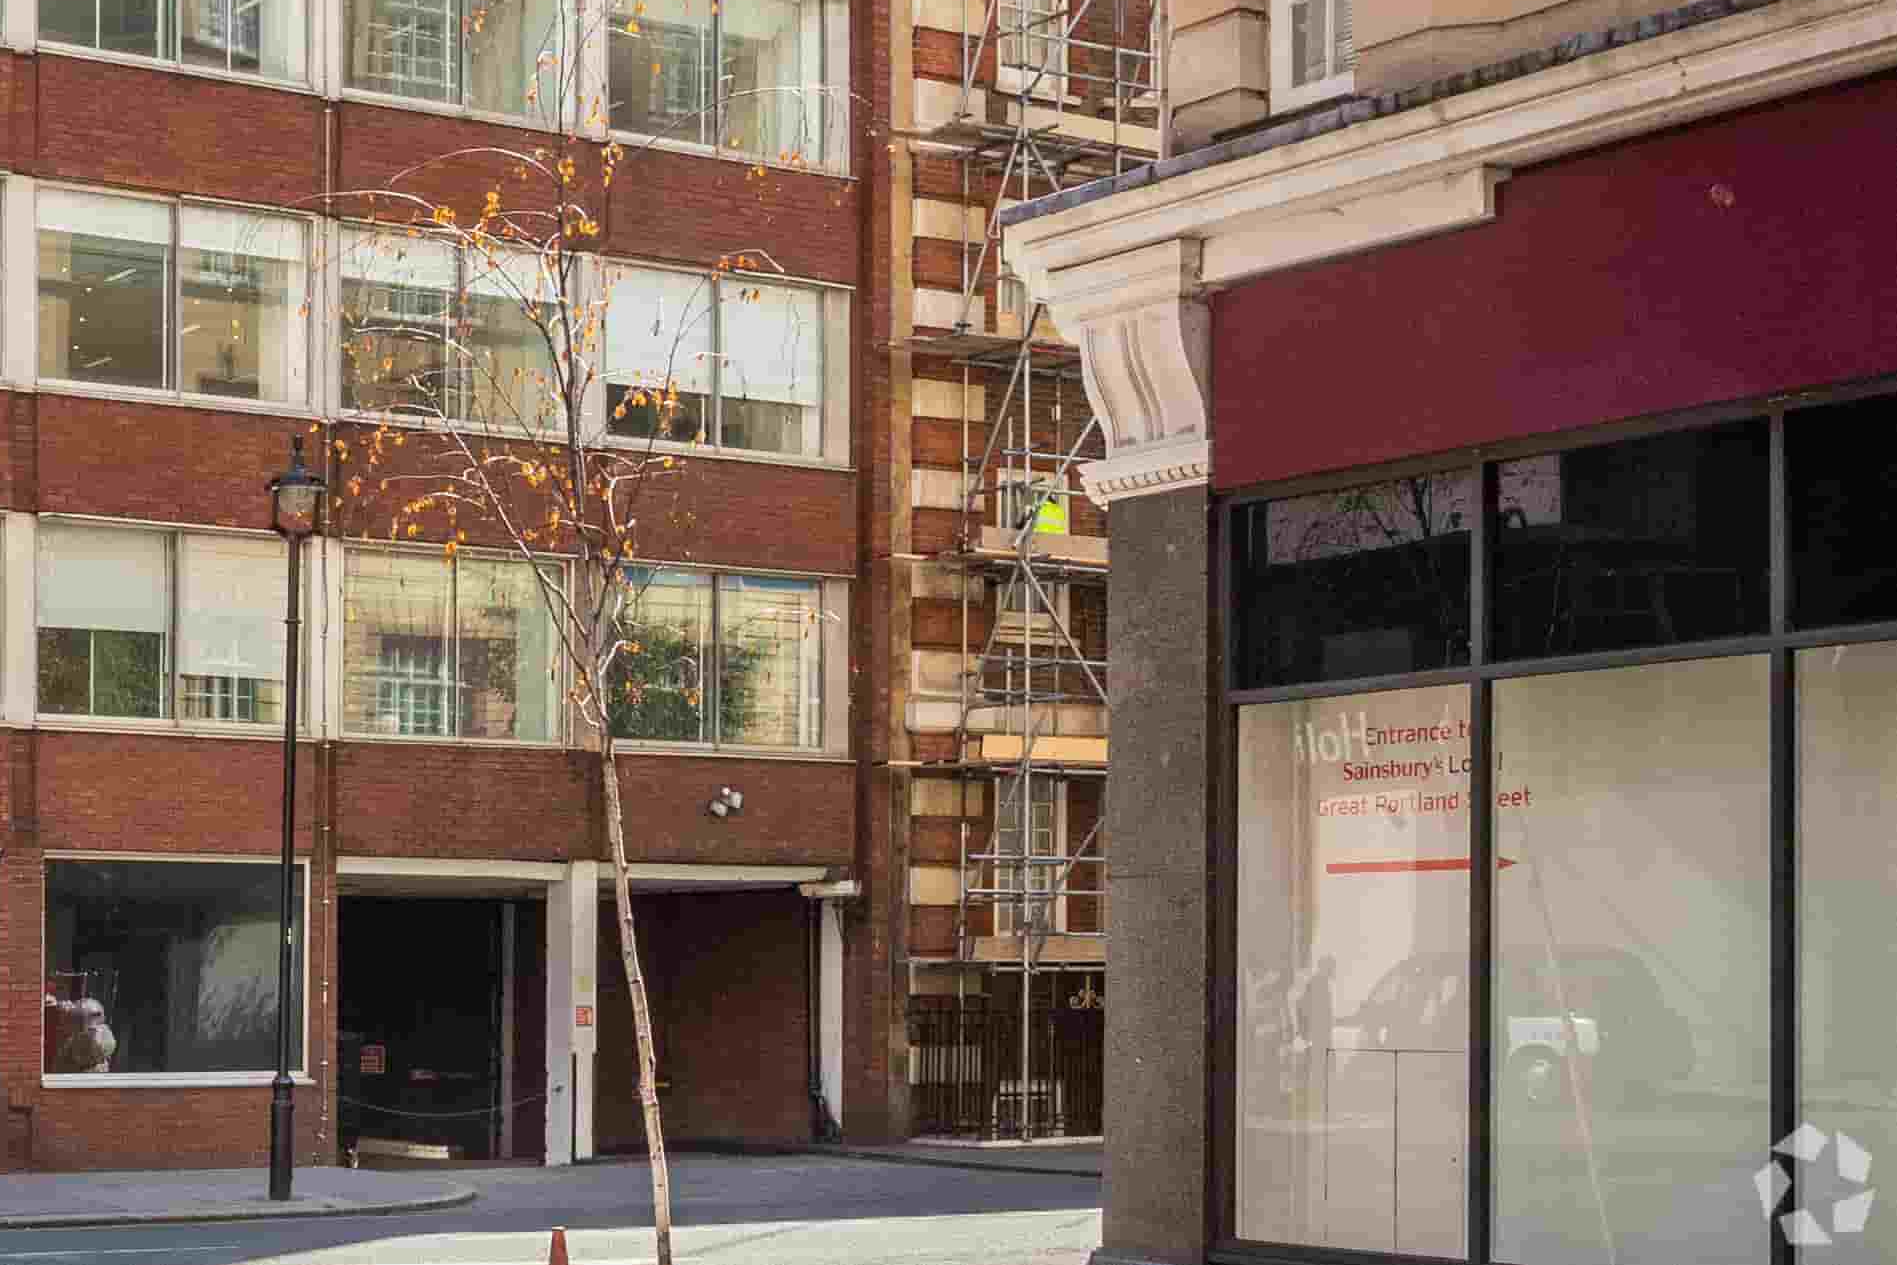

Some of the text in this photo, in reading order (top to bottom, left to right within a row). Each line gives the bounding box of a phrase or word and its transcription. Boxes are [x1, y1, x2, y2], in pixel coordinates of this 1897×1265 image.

[1366, 724, 1452, 747] Entrance
[1342, 751, 1504, 782] Sainsbury's Lol
[1318, 797, 1368, 817] Great
[1375, 790, 1460, 815] Portland
